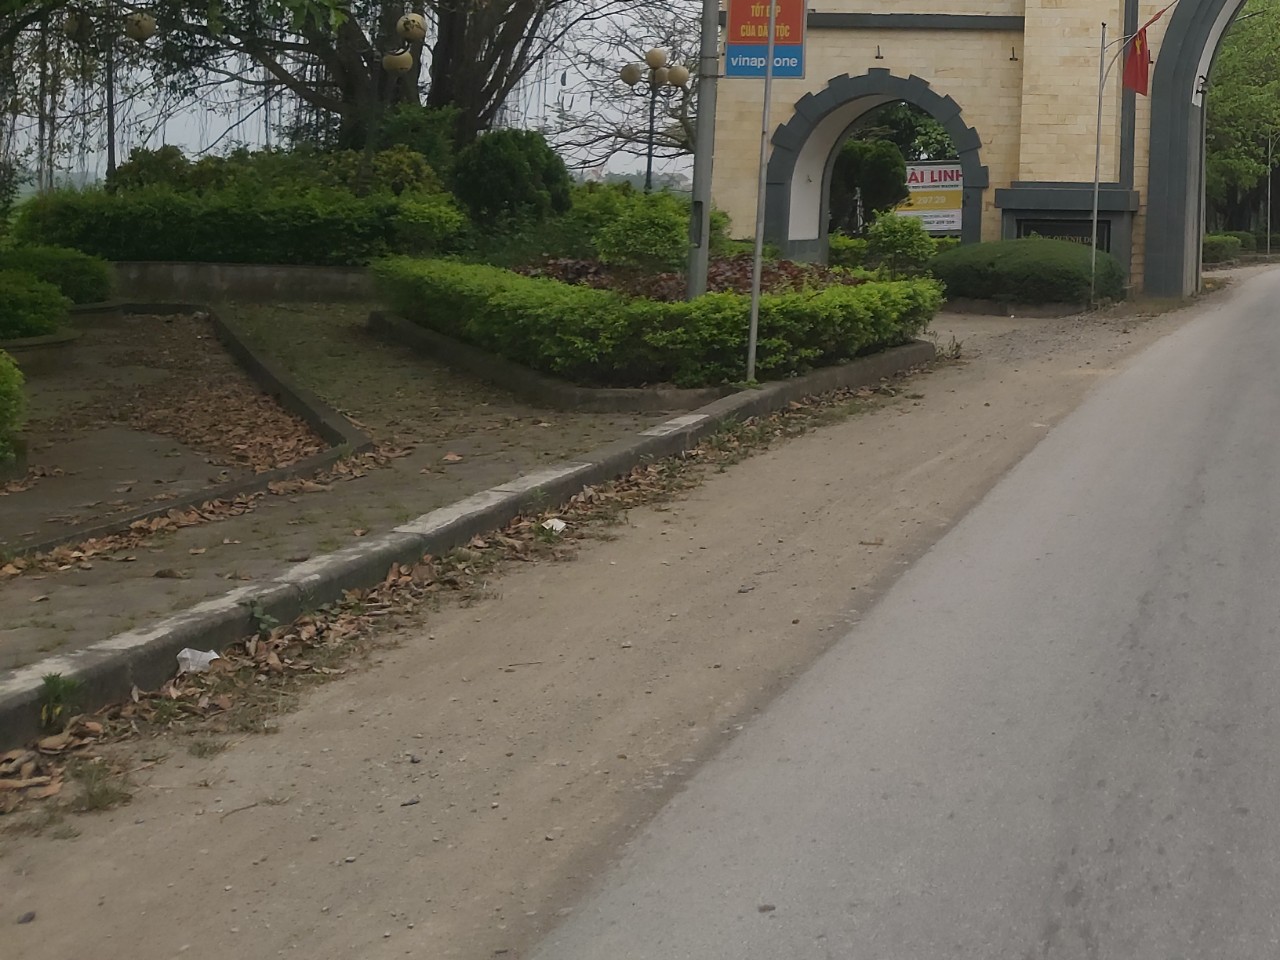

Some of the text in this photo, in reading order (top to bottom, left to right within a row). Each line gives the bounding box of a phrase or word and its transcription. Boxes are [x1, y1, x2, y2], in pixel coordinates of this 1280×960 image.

[751, 1, 781, 18] TỐT ĐP
[740, 21, 790, 40] CỦA DÂ TỘC
[731, 55, 798, 69] vinapone
[908, 168, 925, 184] ÀI
